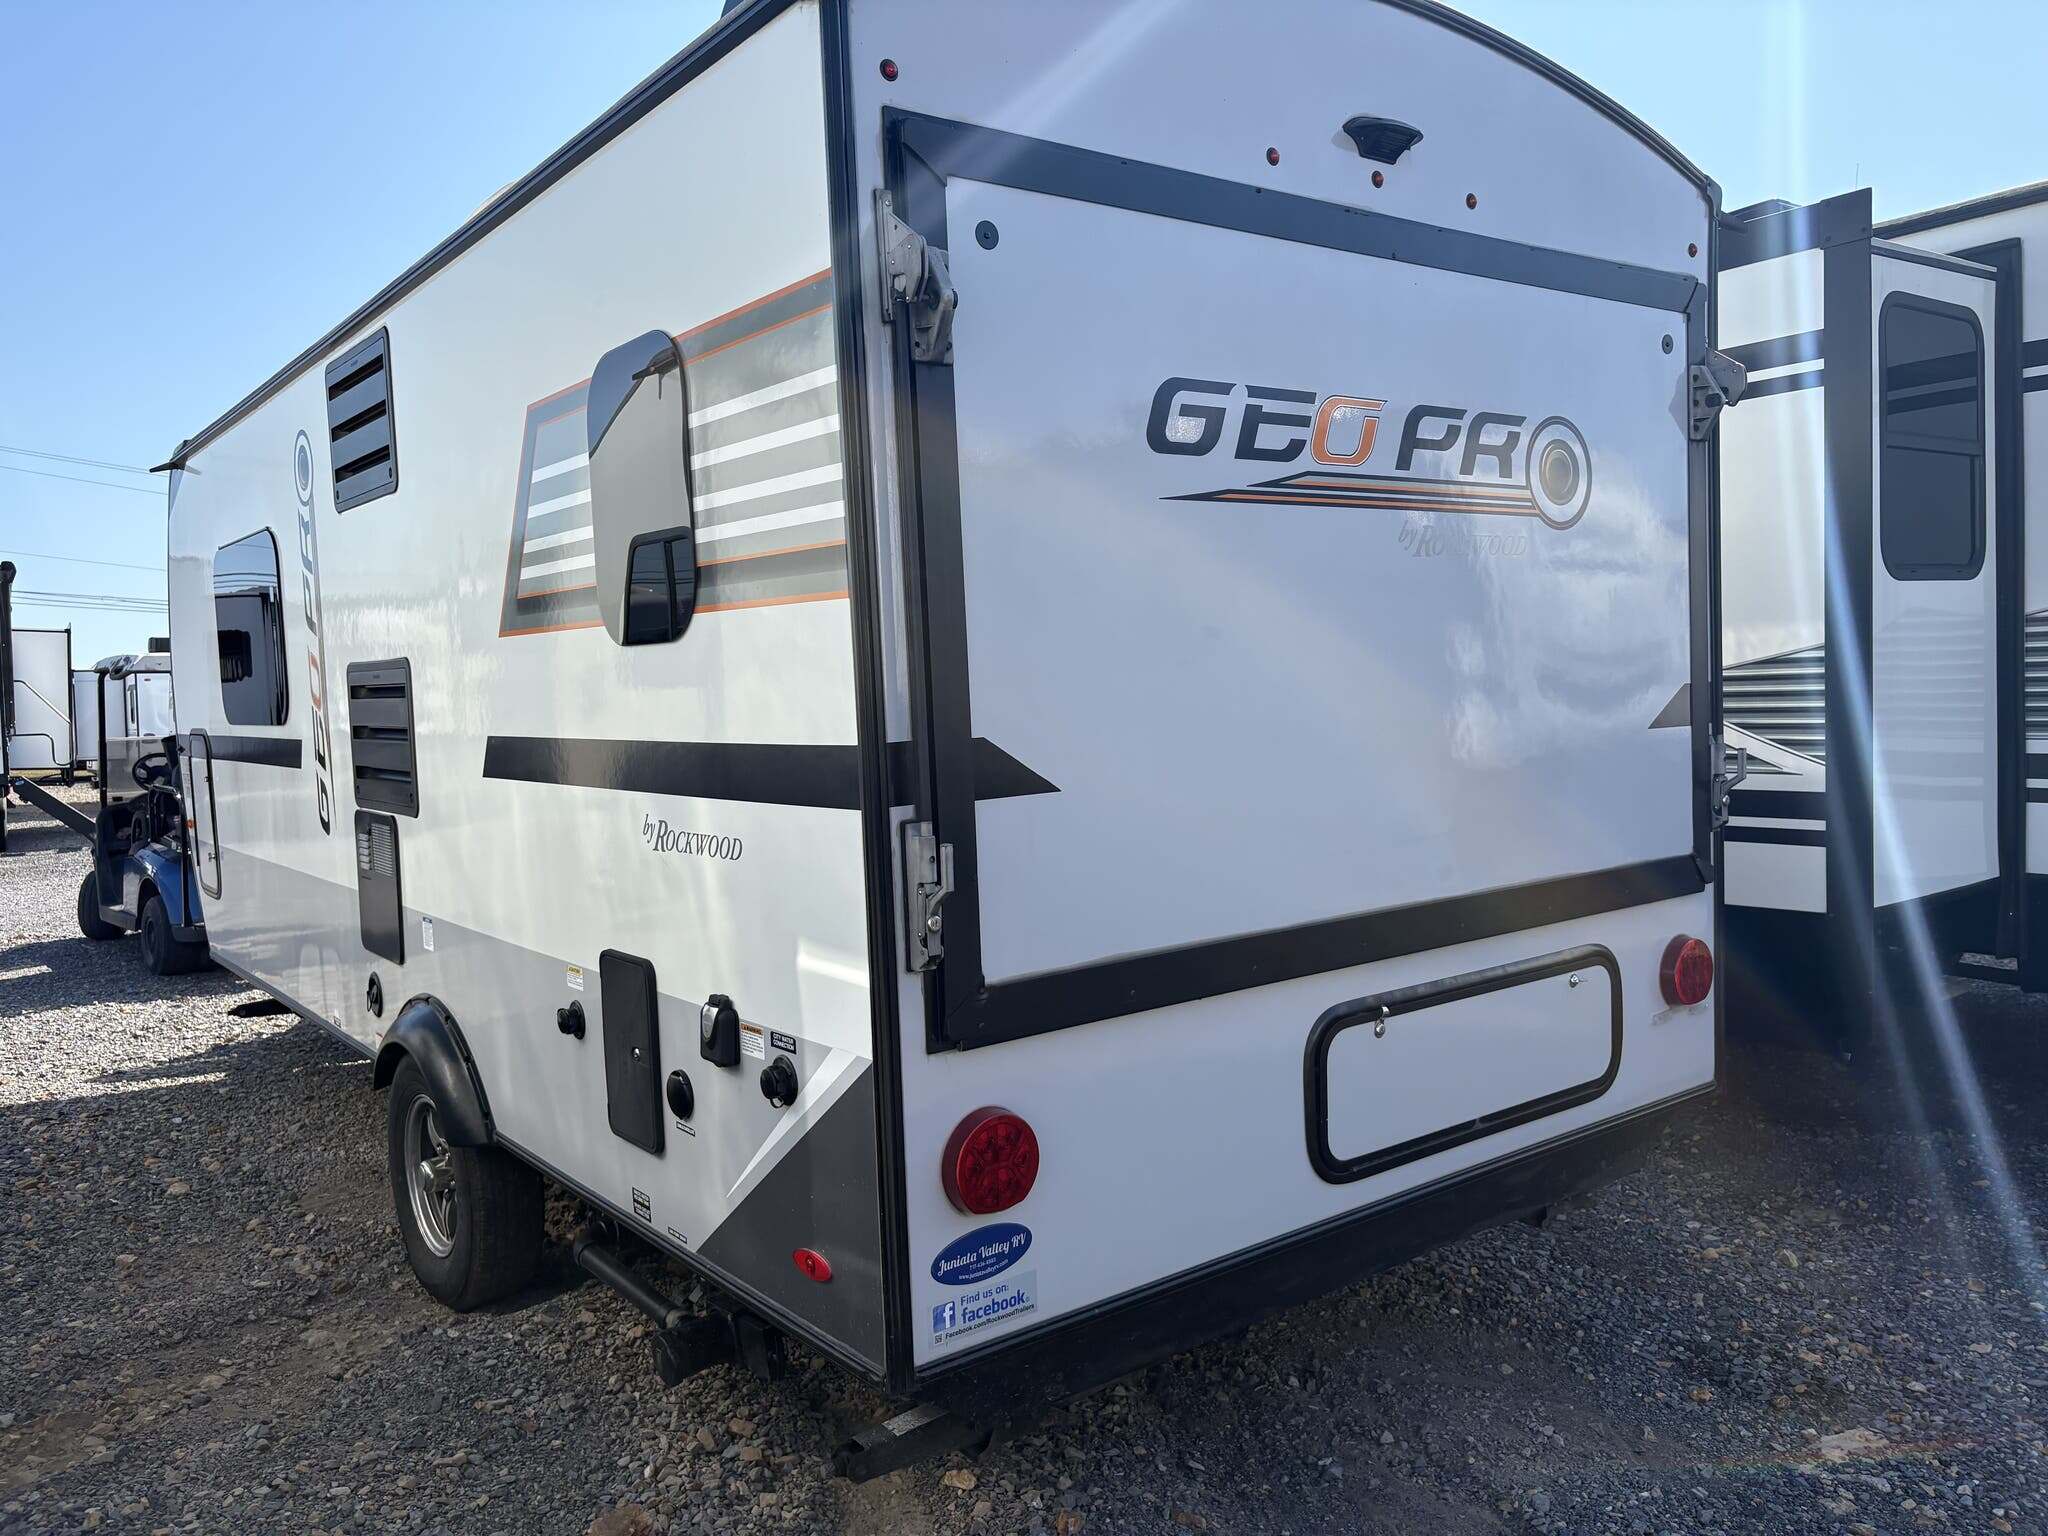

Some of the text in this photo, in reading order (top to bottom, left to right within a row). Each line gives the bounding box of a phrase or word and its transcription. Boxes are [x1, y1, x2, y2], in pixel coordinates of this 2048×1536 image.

[1146, 376, 1593, 531] GEO PRO
[1412, 525, 1528, 558] ROWOOD
[642, 813, 743, 861] by ROCKWOOD
[937, 1231, 1027, 1277] Juniata Valley RV
[960, 1284, 1009, 1307] Find us on:
[961, 1289, 1026, 1324] facebook
